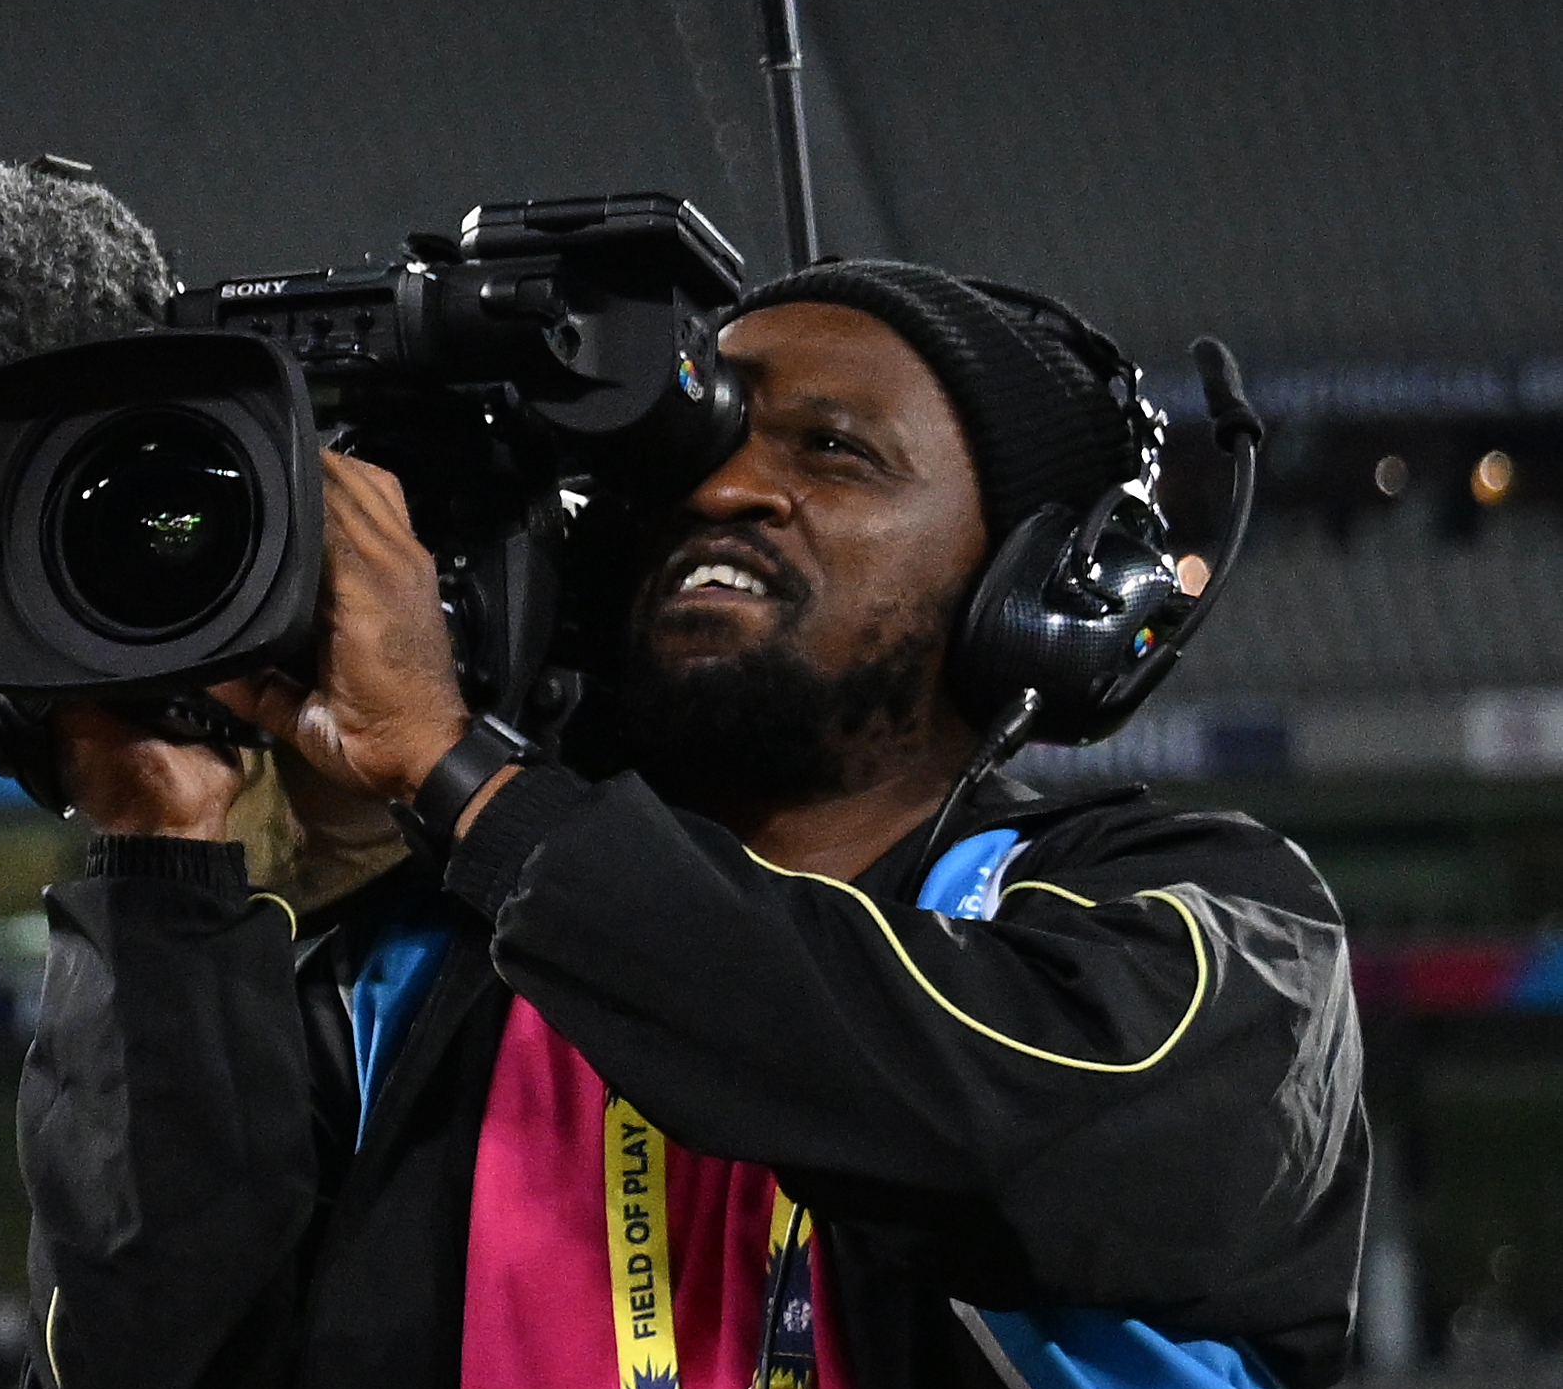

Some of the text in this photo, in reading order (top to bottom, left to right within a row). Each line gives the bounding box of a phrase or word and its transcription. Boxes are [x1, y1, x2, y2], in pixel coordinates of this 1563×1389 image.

[220, 279, 289, 298] SONY
[620, 1122, 657, 1339] FIELD OF PLAY
